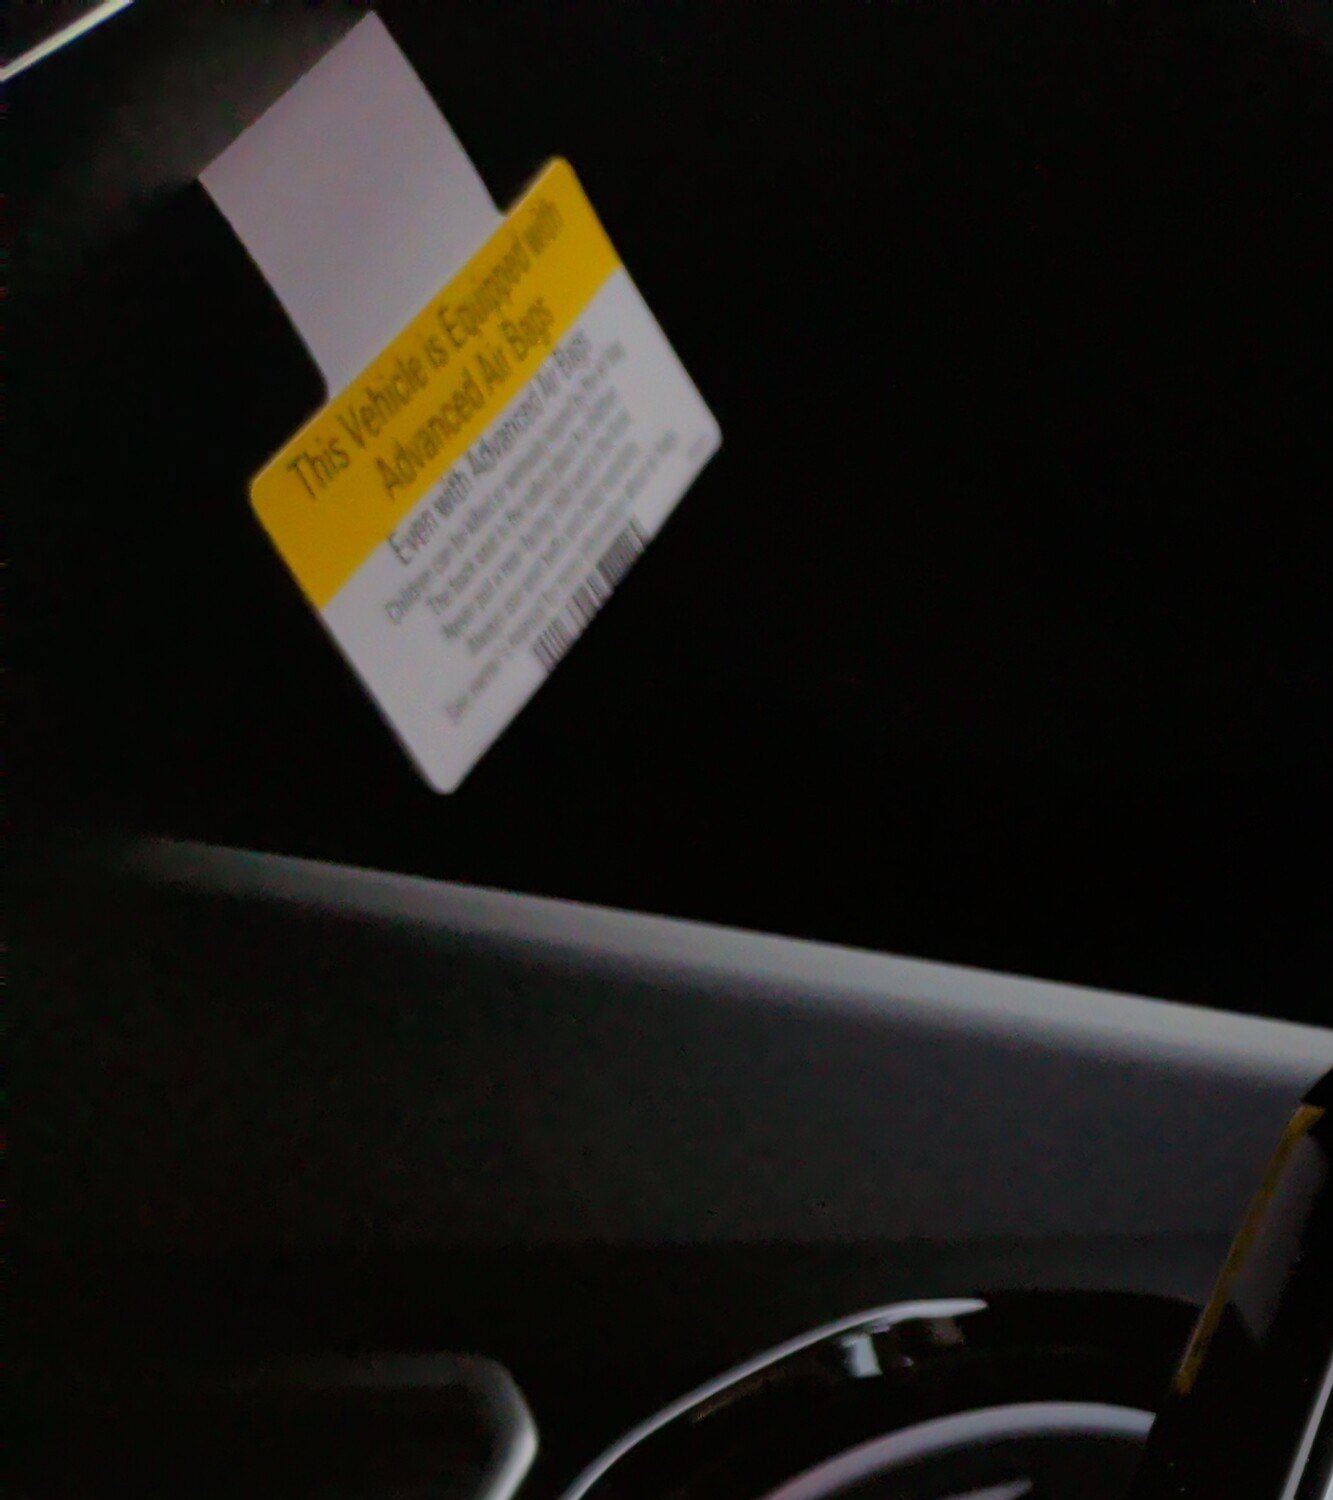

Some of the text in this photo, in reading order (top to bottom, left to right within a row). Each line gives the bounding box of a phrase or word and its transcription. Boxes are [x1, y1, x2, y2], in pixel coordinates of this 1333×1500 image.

[288, 197, 566, 502] This Vehicle is Equipped with
[373, 366, 487, 501] Advanced
[470, 336, 514, 393] Air
[499, 289, 559, 369] Bags
[388, 506, 441, 567] Even
[431, 466, 474, 520] with
[465, 385, 546, 483] Advanced
[535, 362, 562, 400] Air
[553, 326, 596, 384] Bags
